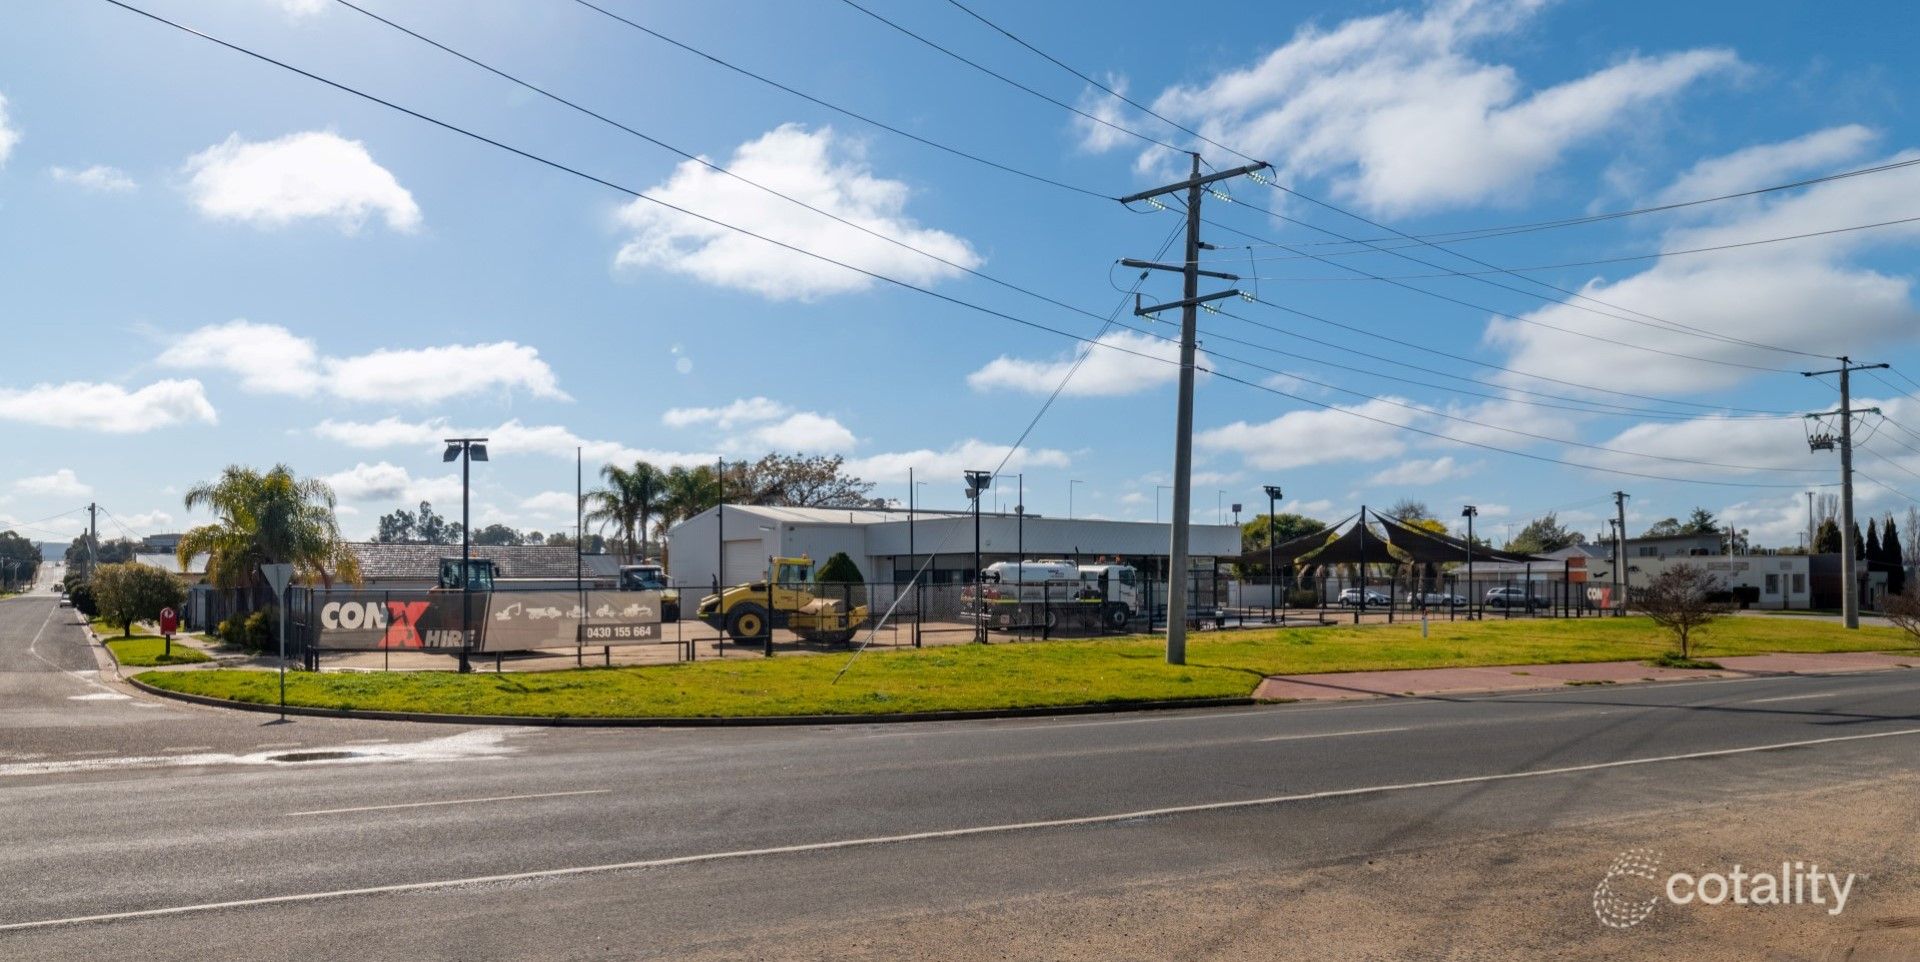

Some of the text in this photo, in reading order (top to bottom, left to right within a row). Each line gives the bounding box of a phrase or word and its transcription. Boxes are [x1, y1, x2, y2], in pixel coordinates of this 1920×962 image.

[424, 629, 475, 648] HIRE
[587, 625, 651, 638] 0430 155 664
